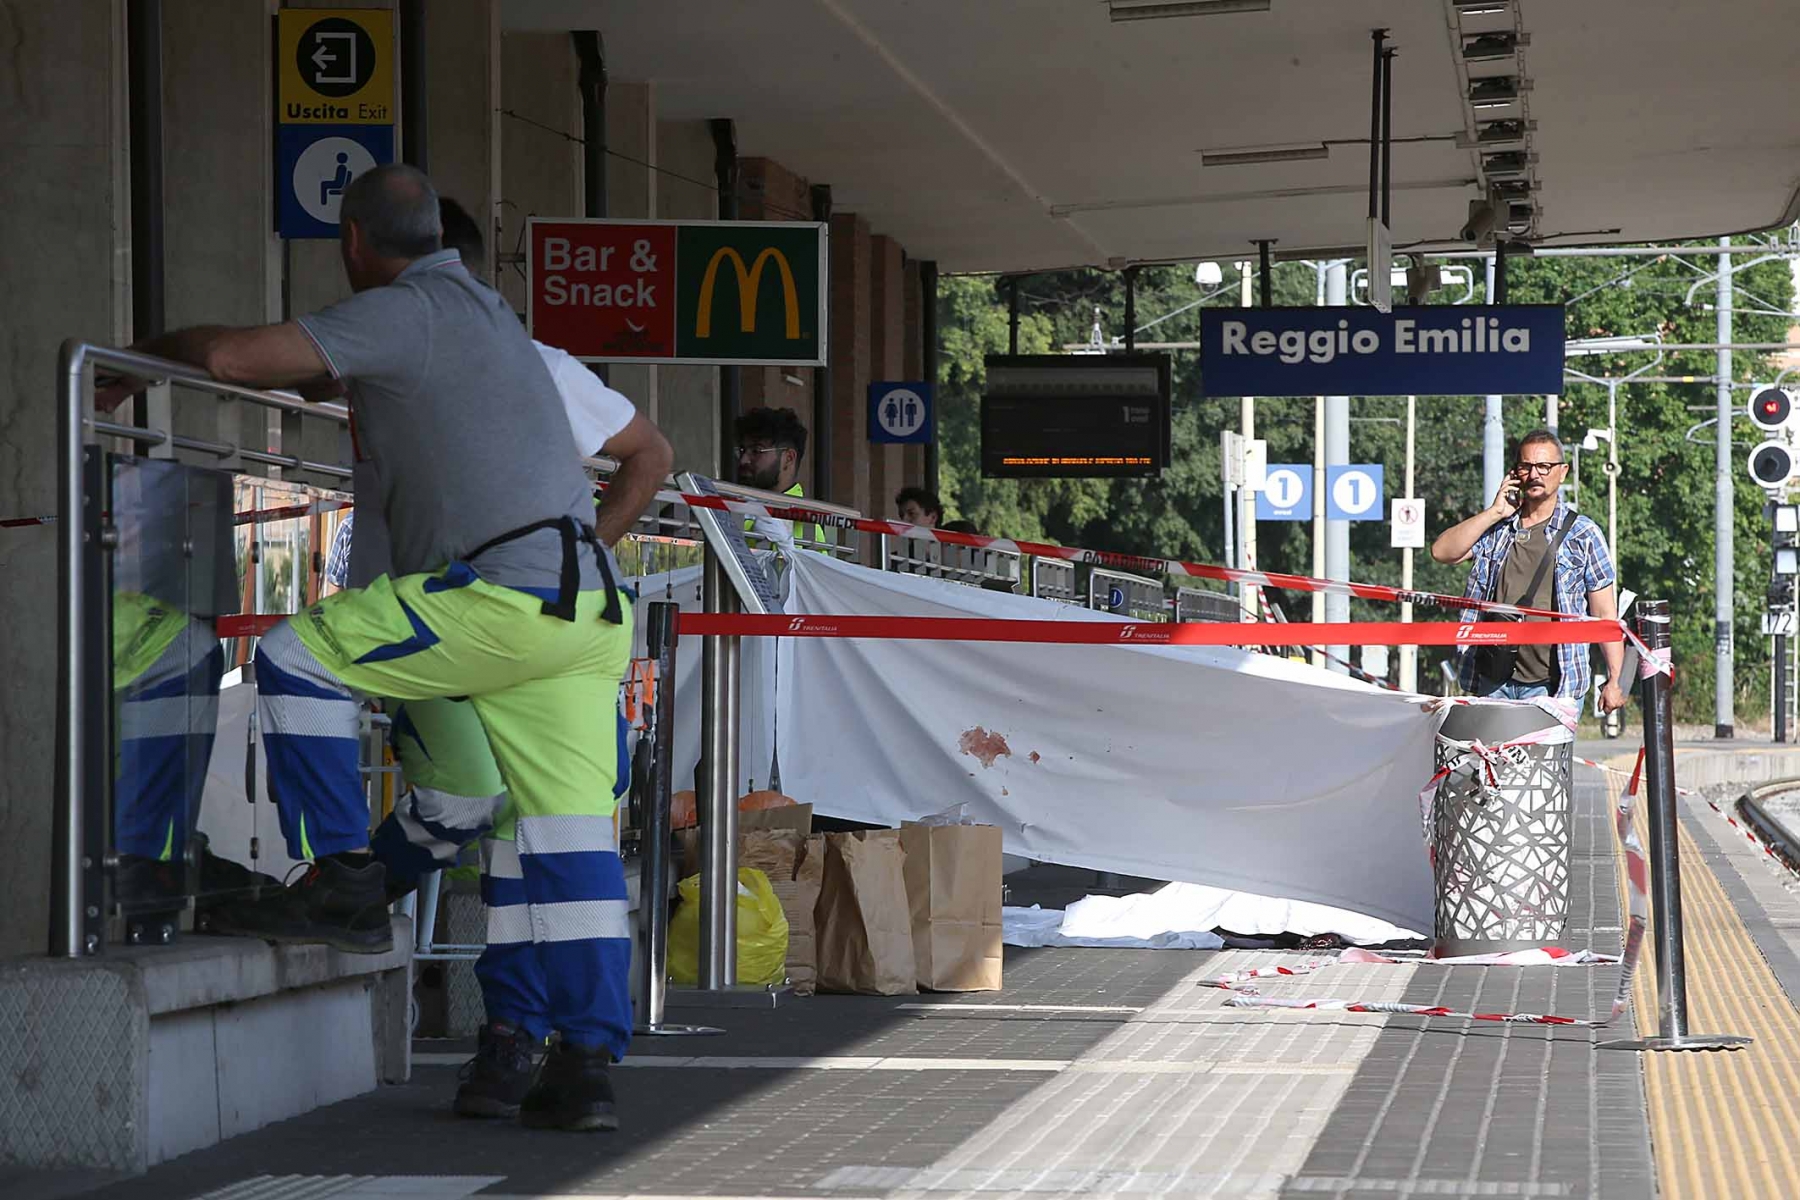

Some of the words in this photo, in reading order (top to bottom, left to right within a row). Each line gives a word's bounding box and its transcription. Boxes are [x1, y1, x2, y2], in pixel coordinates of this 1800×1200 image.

[287, 103, 349, 119] Uscita
[359, 103, 388, 119] Exit
[544, 237, 615, 272] Bar
[630, 239, 658, 272] &
[543, 275, 657, 307] Snack
[1222, 319, 1380, 364] Reggio
[1395, 316, 1530, 353] Emilia
[1278, 477, 1288, 501] 1
[1348, 479, 1360, 505] 1
[1767, 613, 1792, 633] 172
